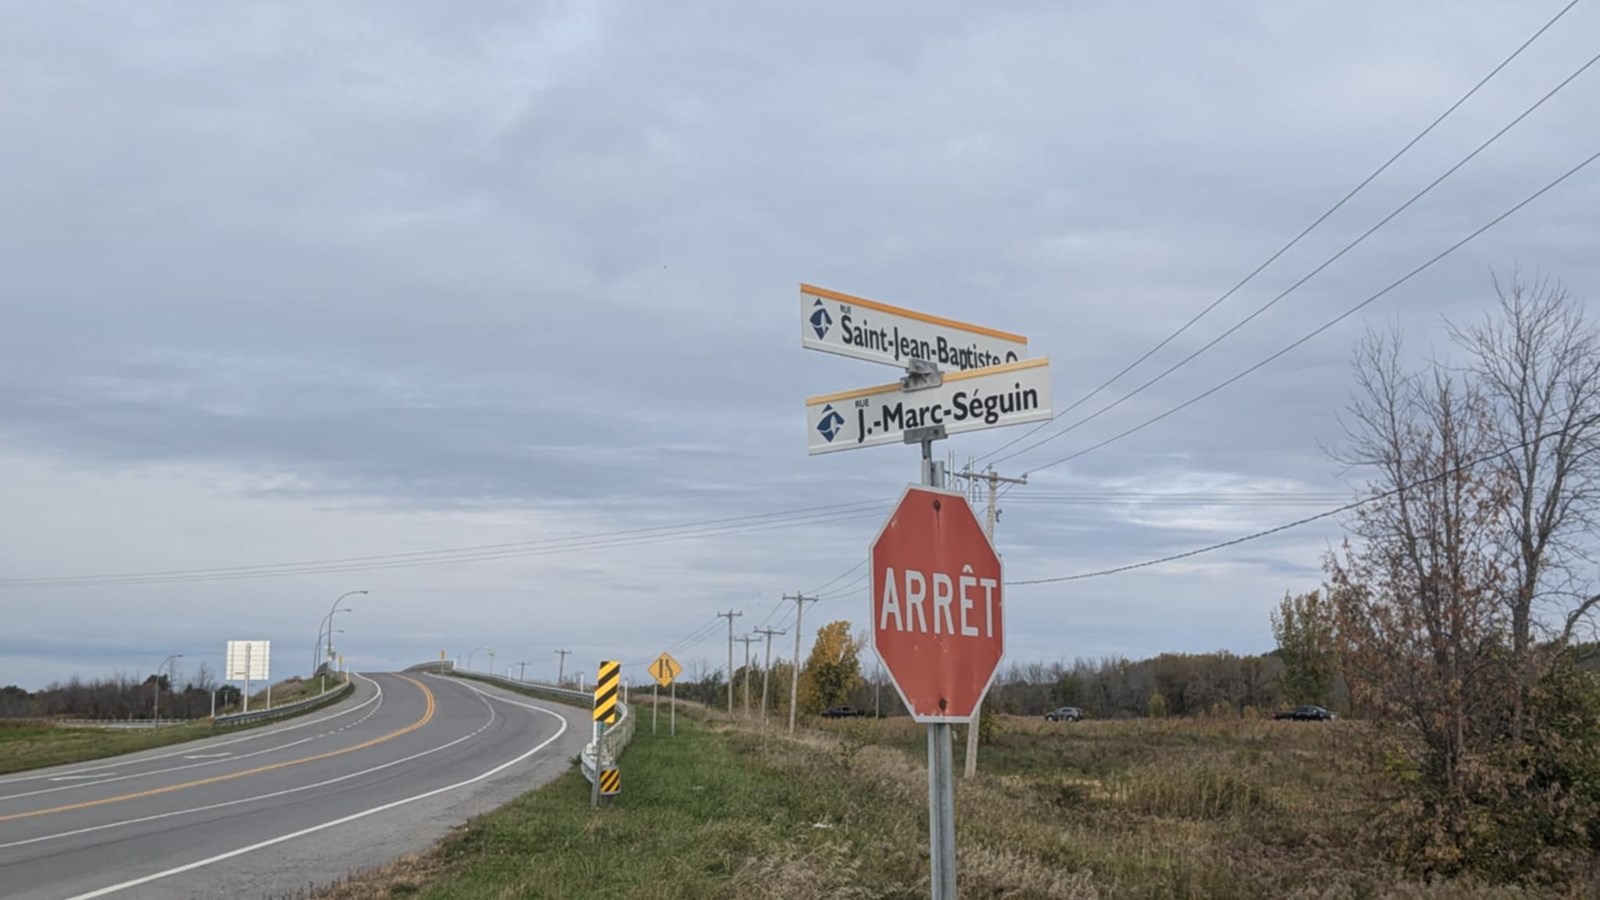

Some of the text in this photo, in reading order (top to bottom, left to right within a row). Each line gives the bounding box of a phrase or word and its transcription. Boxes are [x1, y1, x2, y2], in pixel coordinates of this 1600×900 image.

[840, 304, 852, 315] RUE
[841, 314, 1001, 371] Saint-Jean-Baptiste
[855, 398, 869, 409] RUE
[857, 382, 1038, 443] J.-Marc-Séguin
[880, 564, 997, 637] ARRÊT
